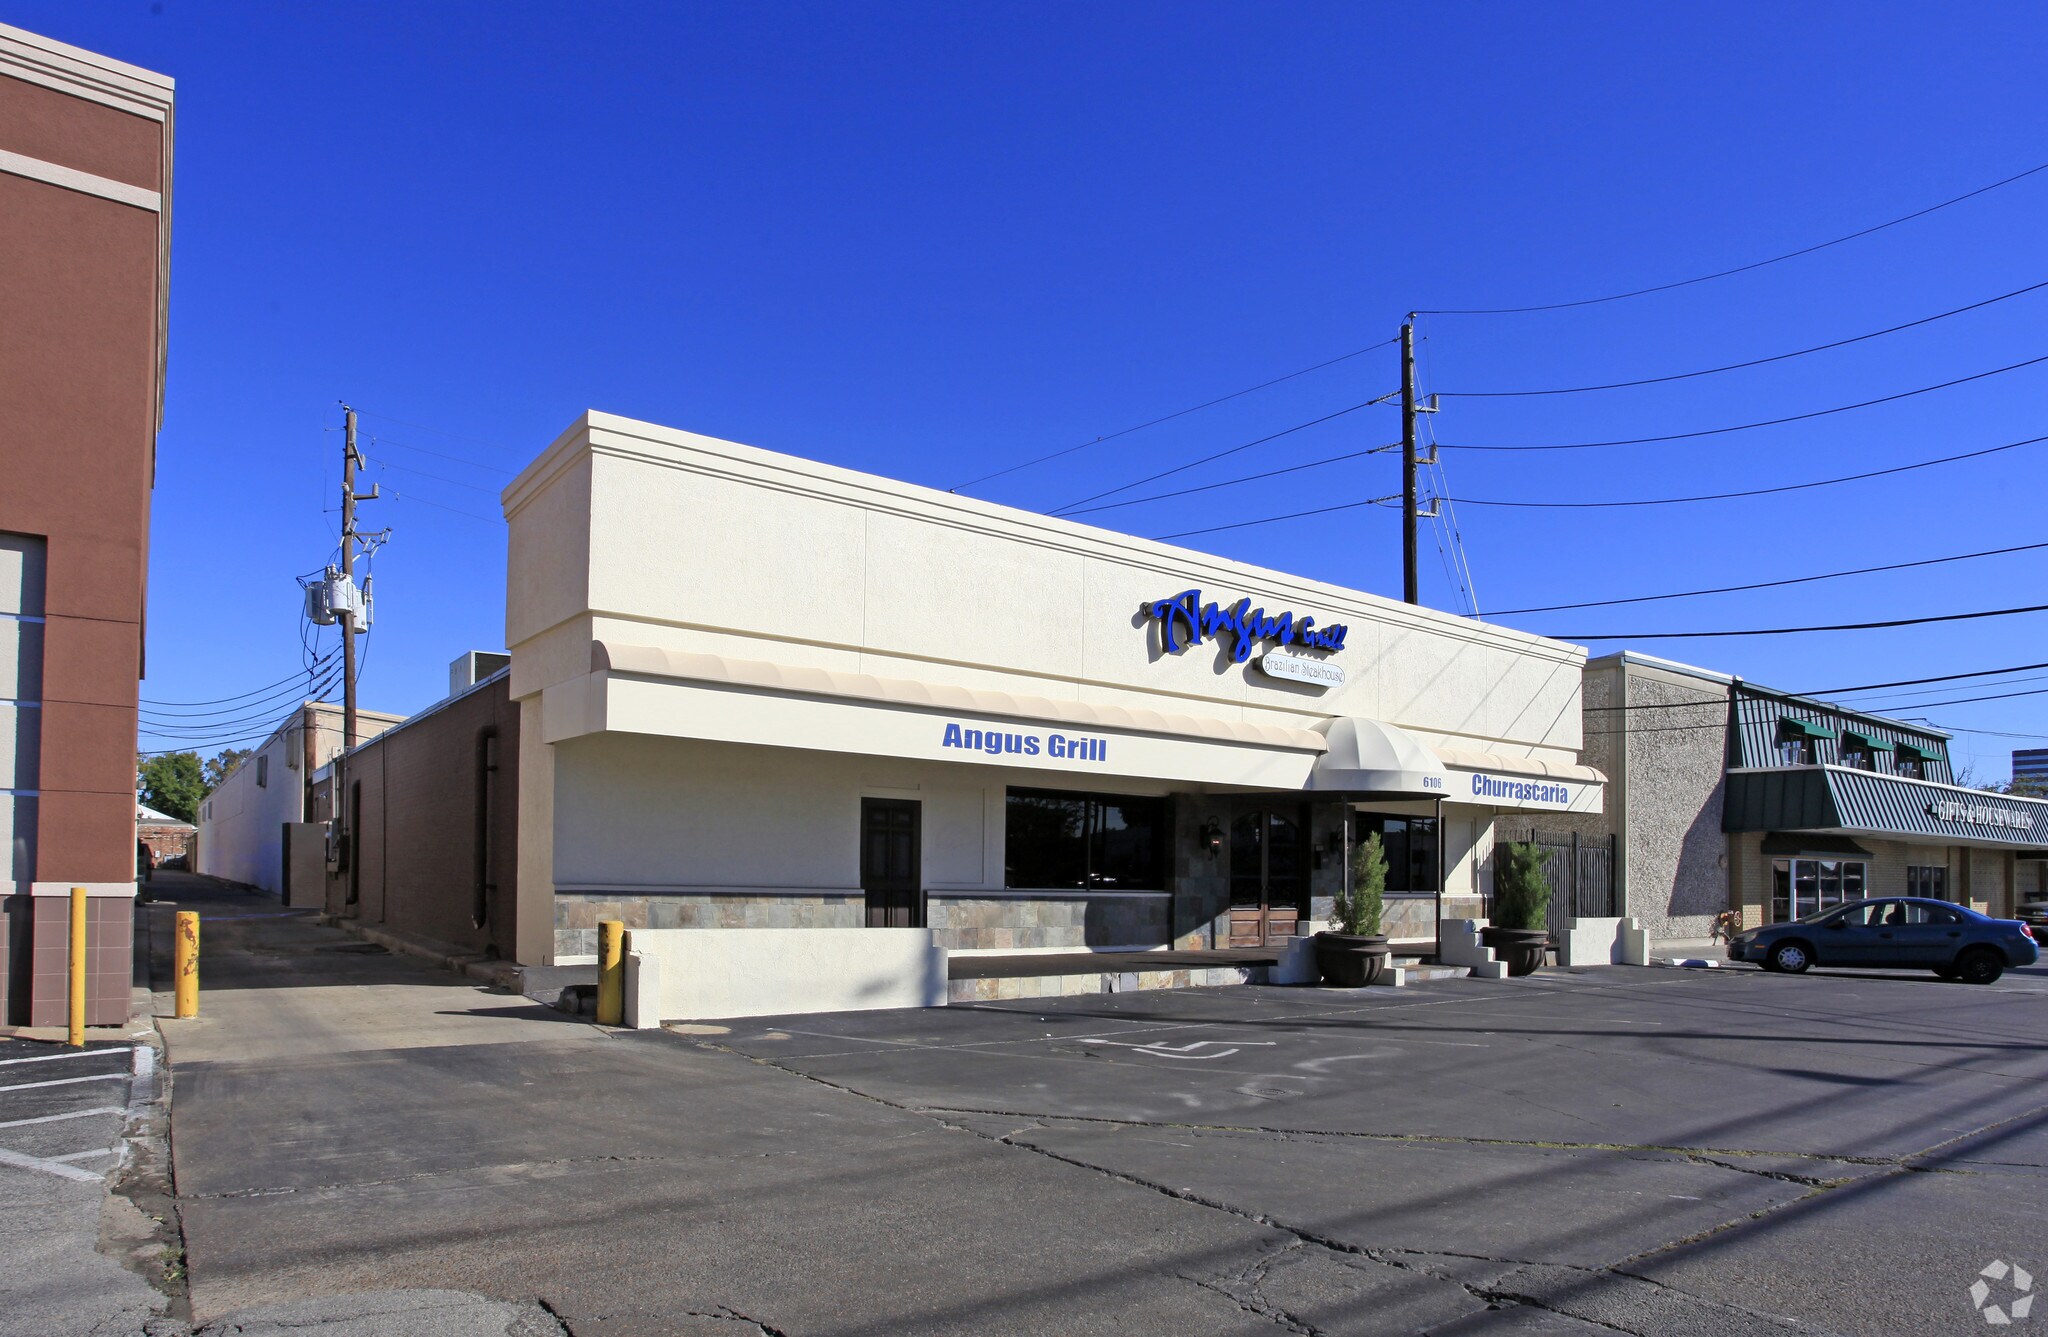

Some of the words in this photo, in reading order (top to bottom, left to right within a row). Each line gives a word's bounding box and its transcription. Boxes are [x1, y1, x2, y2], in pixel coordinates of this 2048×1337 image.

[1153, 589, 1294, 663] Angus
[1304, 616, 1348, 650] Grill
[1265, 656, 1300, 674] Brazilian
[1301, 662, 1343, 682] Steakhouse
[942, 723, 1040, 756] Angus
[1048, 734, 1107, 762] Grill
[1423, 776, 1442, 789] 6106
[1472, 773, 1568, 804] Churrascaria
[1938, 800, 1967, 822] GIFTS
[1967, 804, 1975, 823] &
[1976, 805, 2031, 830] HOUSEWARES
